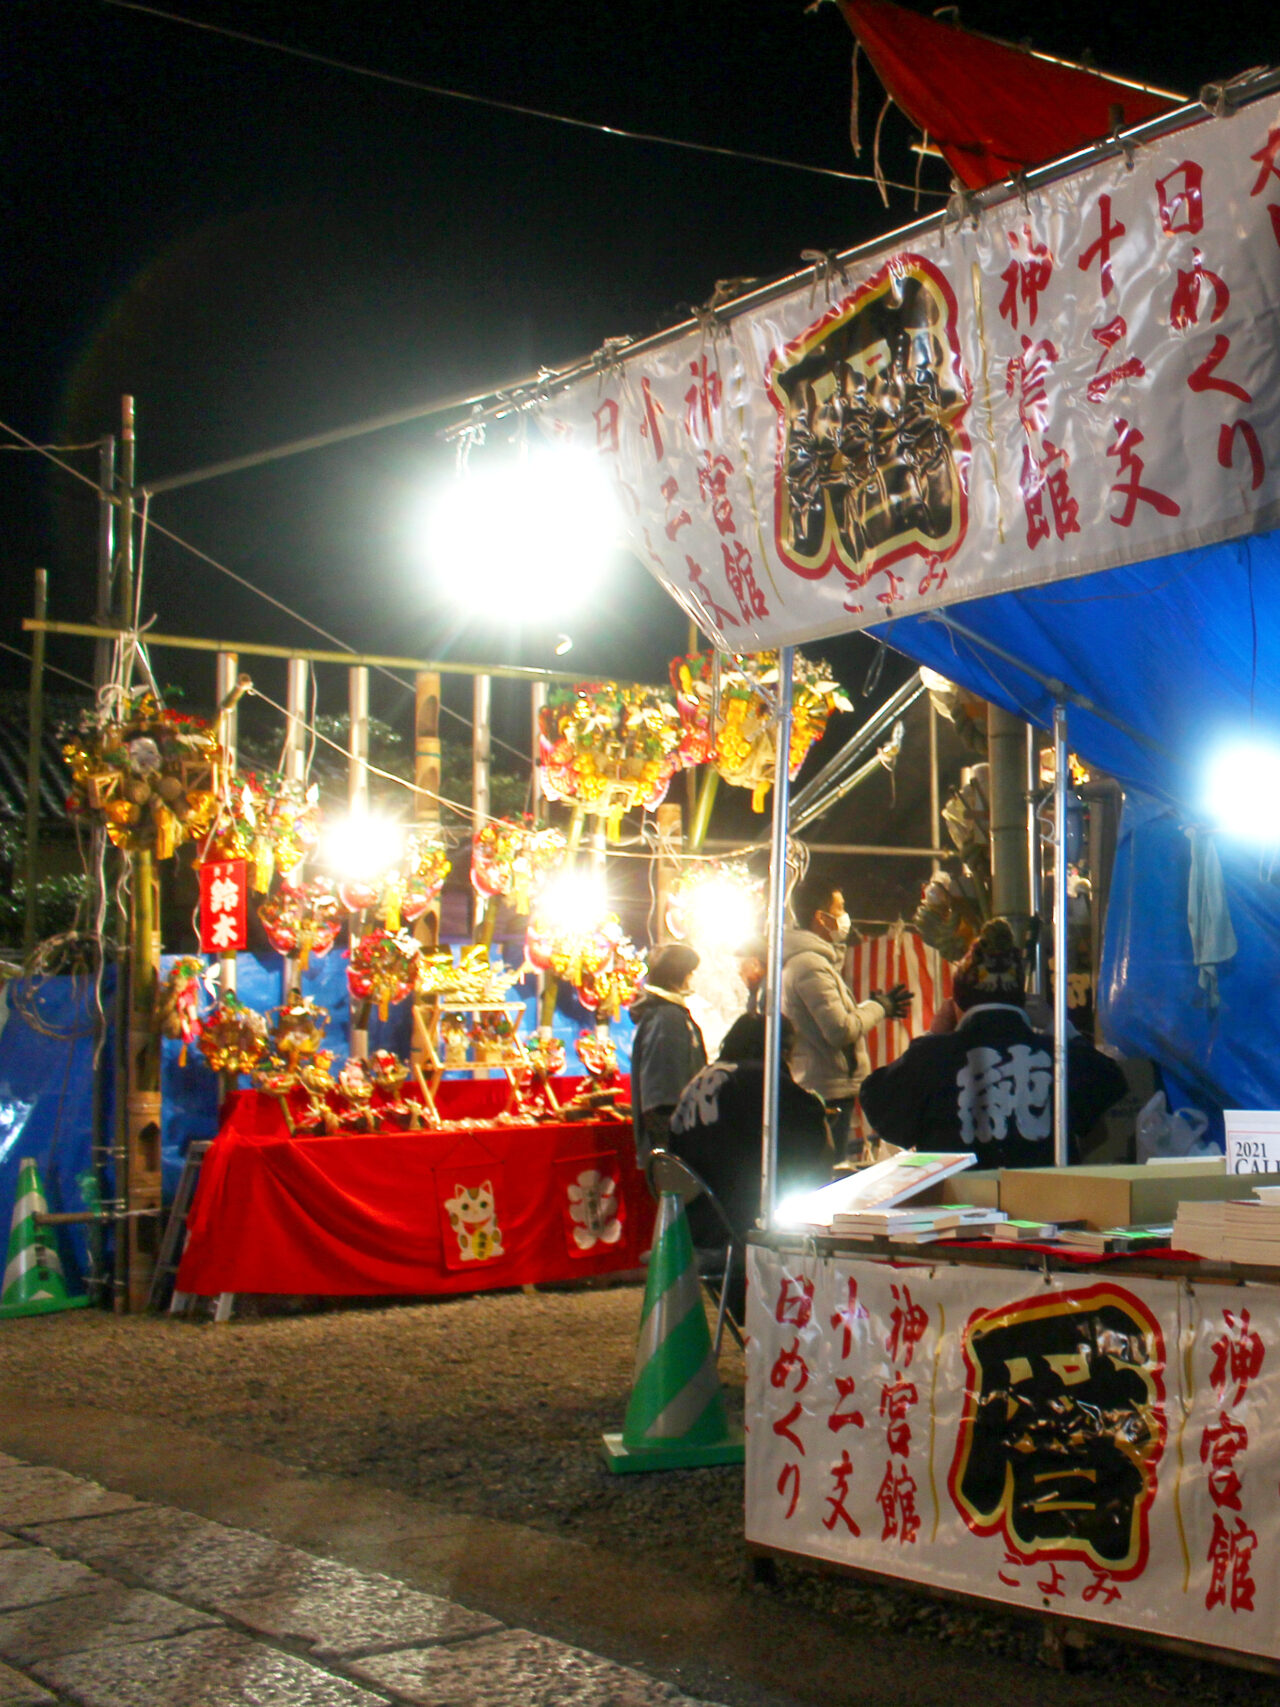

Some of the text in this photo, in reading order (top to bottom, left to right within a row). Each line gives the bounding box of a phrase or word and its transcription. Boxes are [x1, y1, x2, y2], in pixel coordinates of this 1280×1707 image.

[999, 223, 1081, 551] 神宮館
[1078, 194, 1181, 528] 十二支
[1156, 160, 1266, 491] 日めくり
[684, 354, 769, 624] 神宮館
[842, 554, 949, 613] こよみ
[209, 877, 239, 948] 鈴木
[1235, 1141, 1267, 1159] 2021
[770, 1273, 815, 1520] 日めくり
[822, 1275, 871, 1538] 十二支
[876, 1283, 929, 1544] 神宮館
[1200, 1306, 1266, 1614] 神宮館
[998, 1551, 1122, 1604] こよみ
